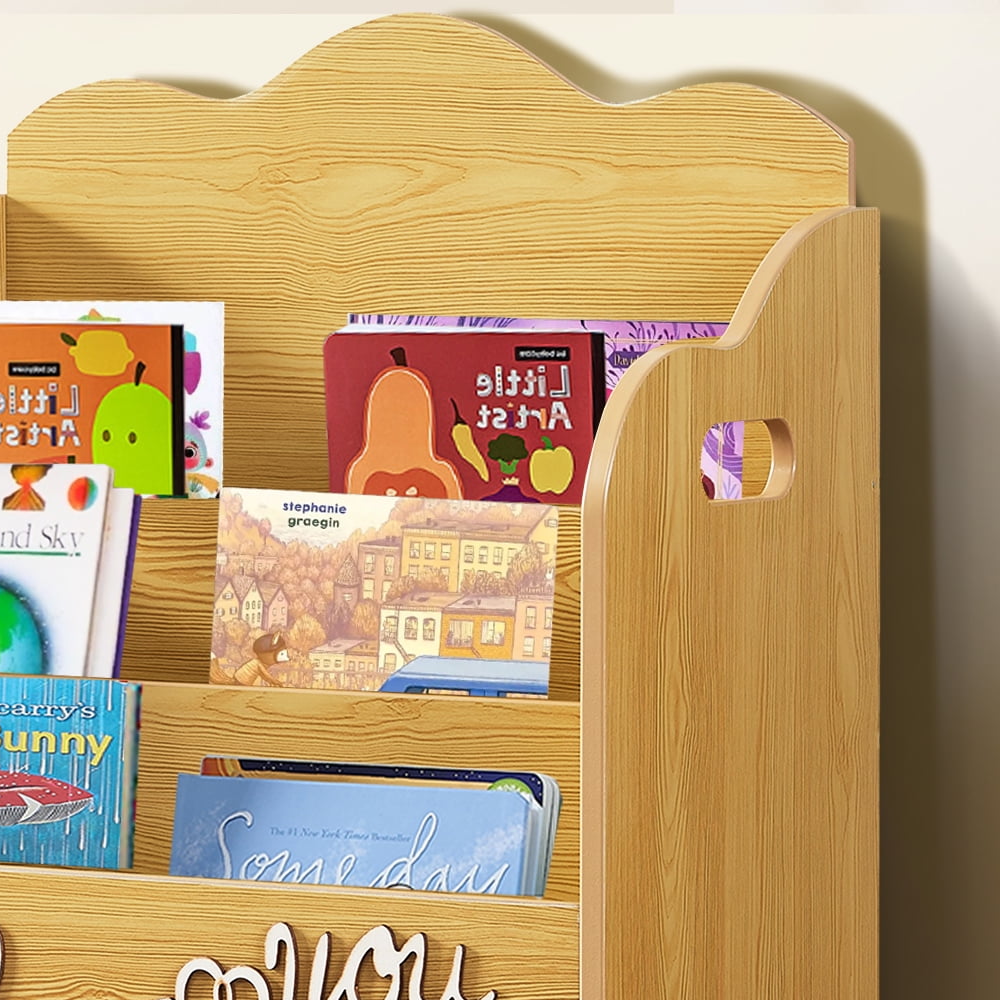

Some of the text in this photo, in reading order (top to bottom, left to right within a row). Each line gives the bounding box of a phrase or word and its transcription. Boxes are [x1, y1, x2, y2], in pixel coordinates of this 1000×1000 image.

[283, 501, 347, 514] stephanie
[288, 517, 340, 530] graegin
[38, 524, 85, 550] Sky
[270, 826, 284, 836] The
[321, 828, 341, 839] York
